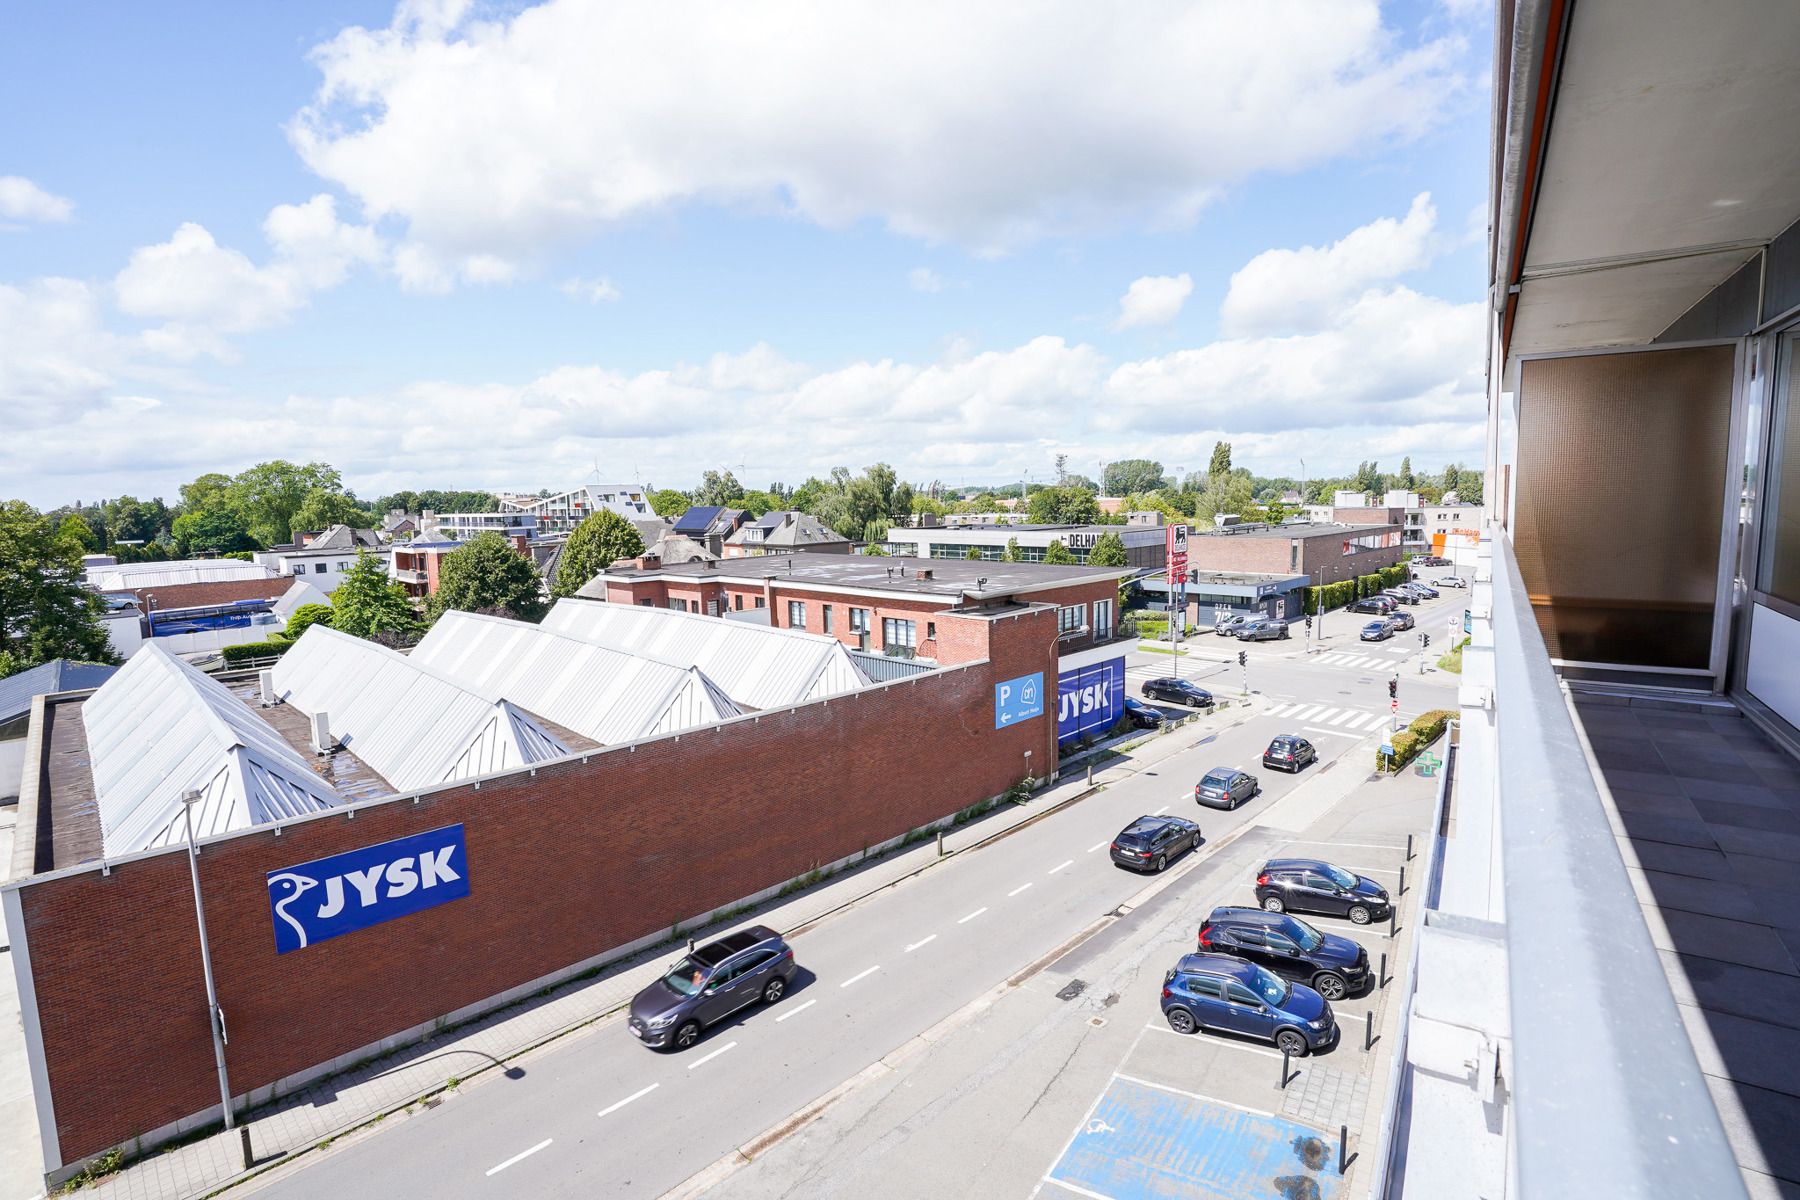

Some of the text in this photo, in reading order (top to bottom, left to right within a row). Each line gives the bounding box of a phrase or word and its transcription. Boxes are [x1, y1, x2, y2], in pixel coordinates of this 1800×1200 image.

[1214, 603, 1232, 611] OPEN
[1000, 685, 1011, 707] P
[1058, 681, 1109, 722] JYSK
[317, 844, 461, 919] JYSK
